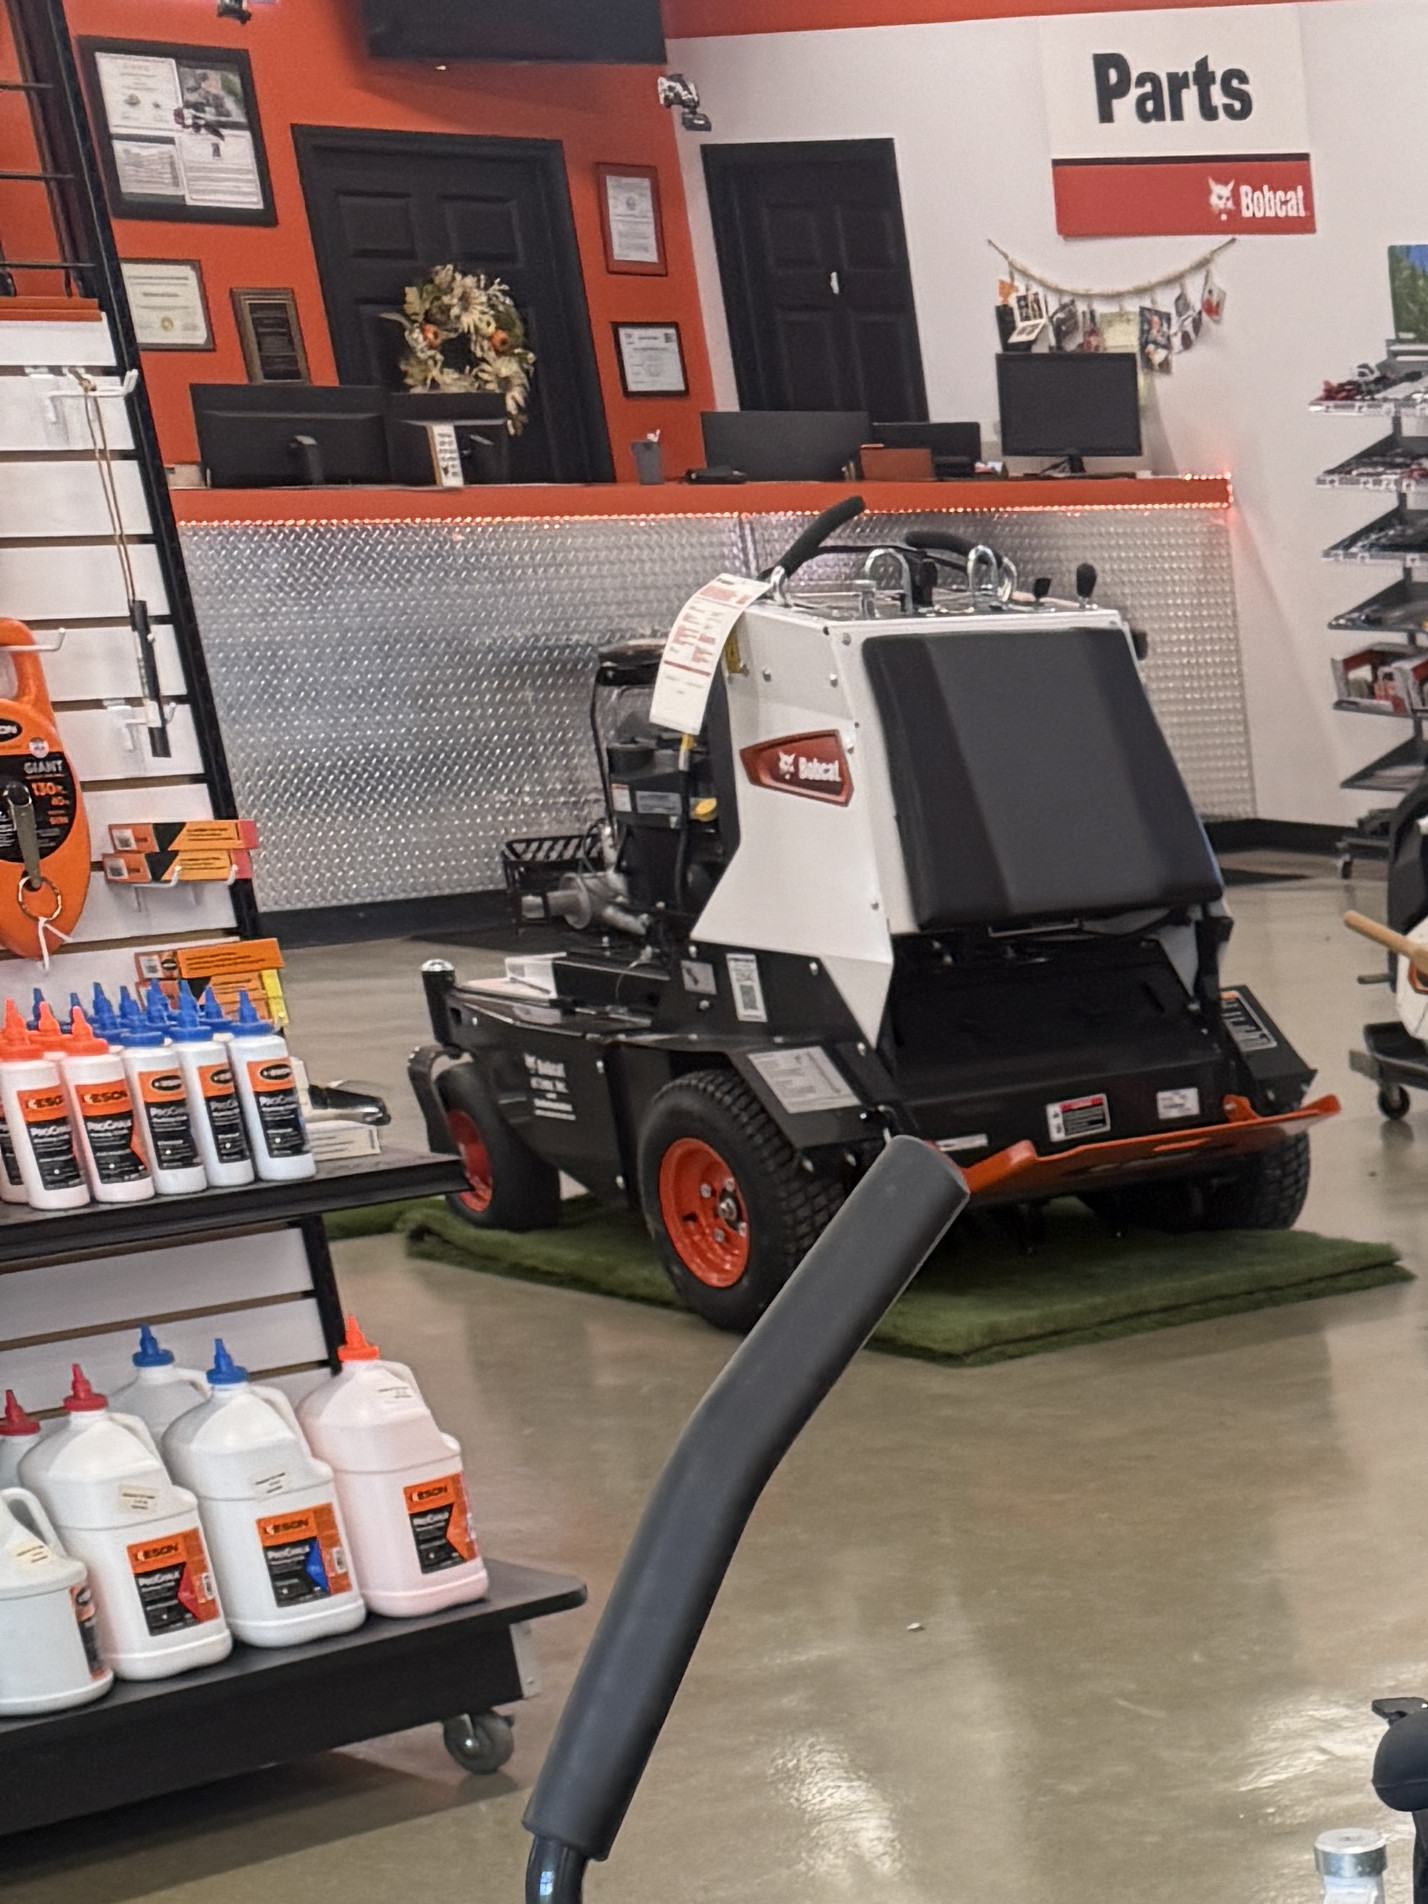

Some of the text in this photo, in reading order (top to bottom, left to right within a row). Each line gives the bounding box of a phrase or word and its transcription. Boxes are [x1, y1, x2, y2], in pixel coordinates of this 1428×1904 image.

[1092, 52, 1254, 124] Parts
[1239, 184, 1306, 218] Bobcat
[23, 759, 64, 774] GIANT
[798, 756, 842, 782] Bobcat
